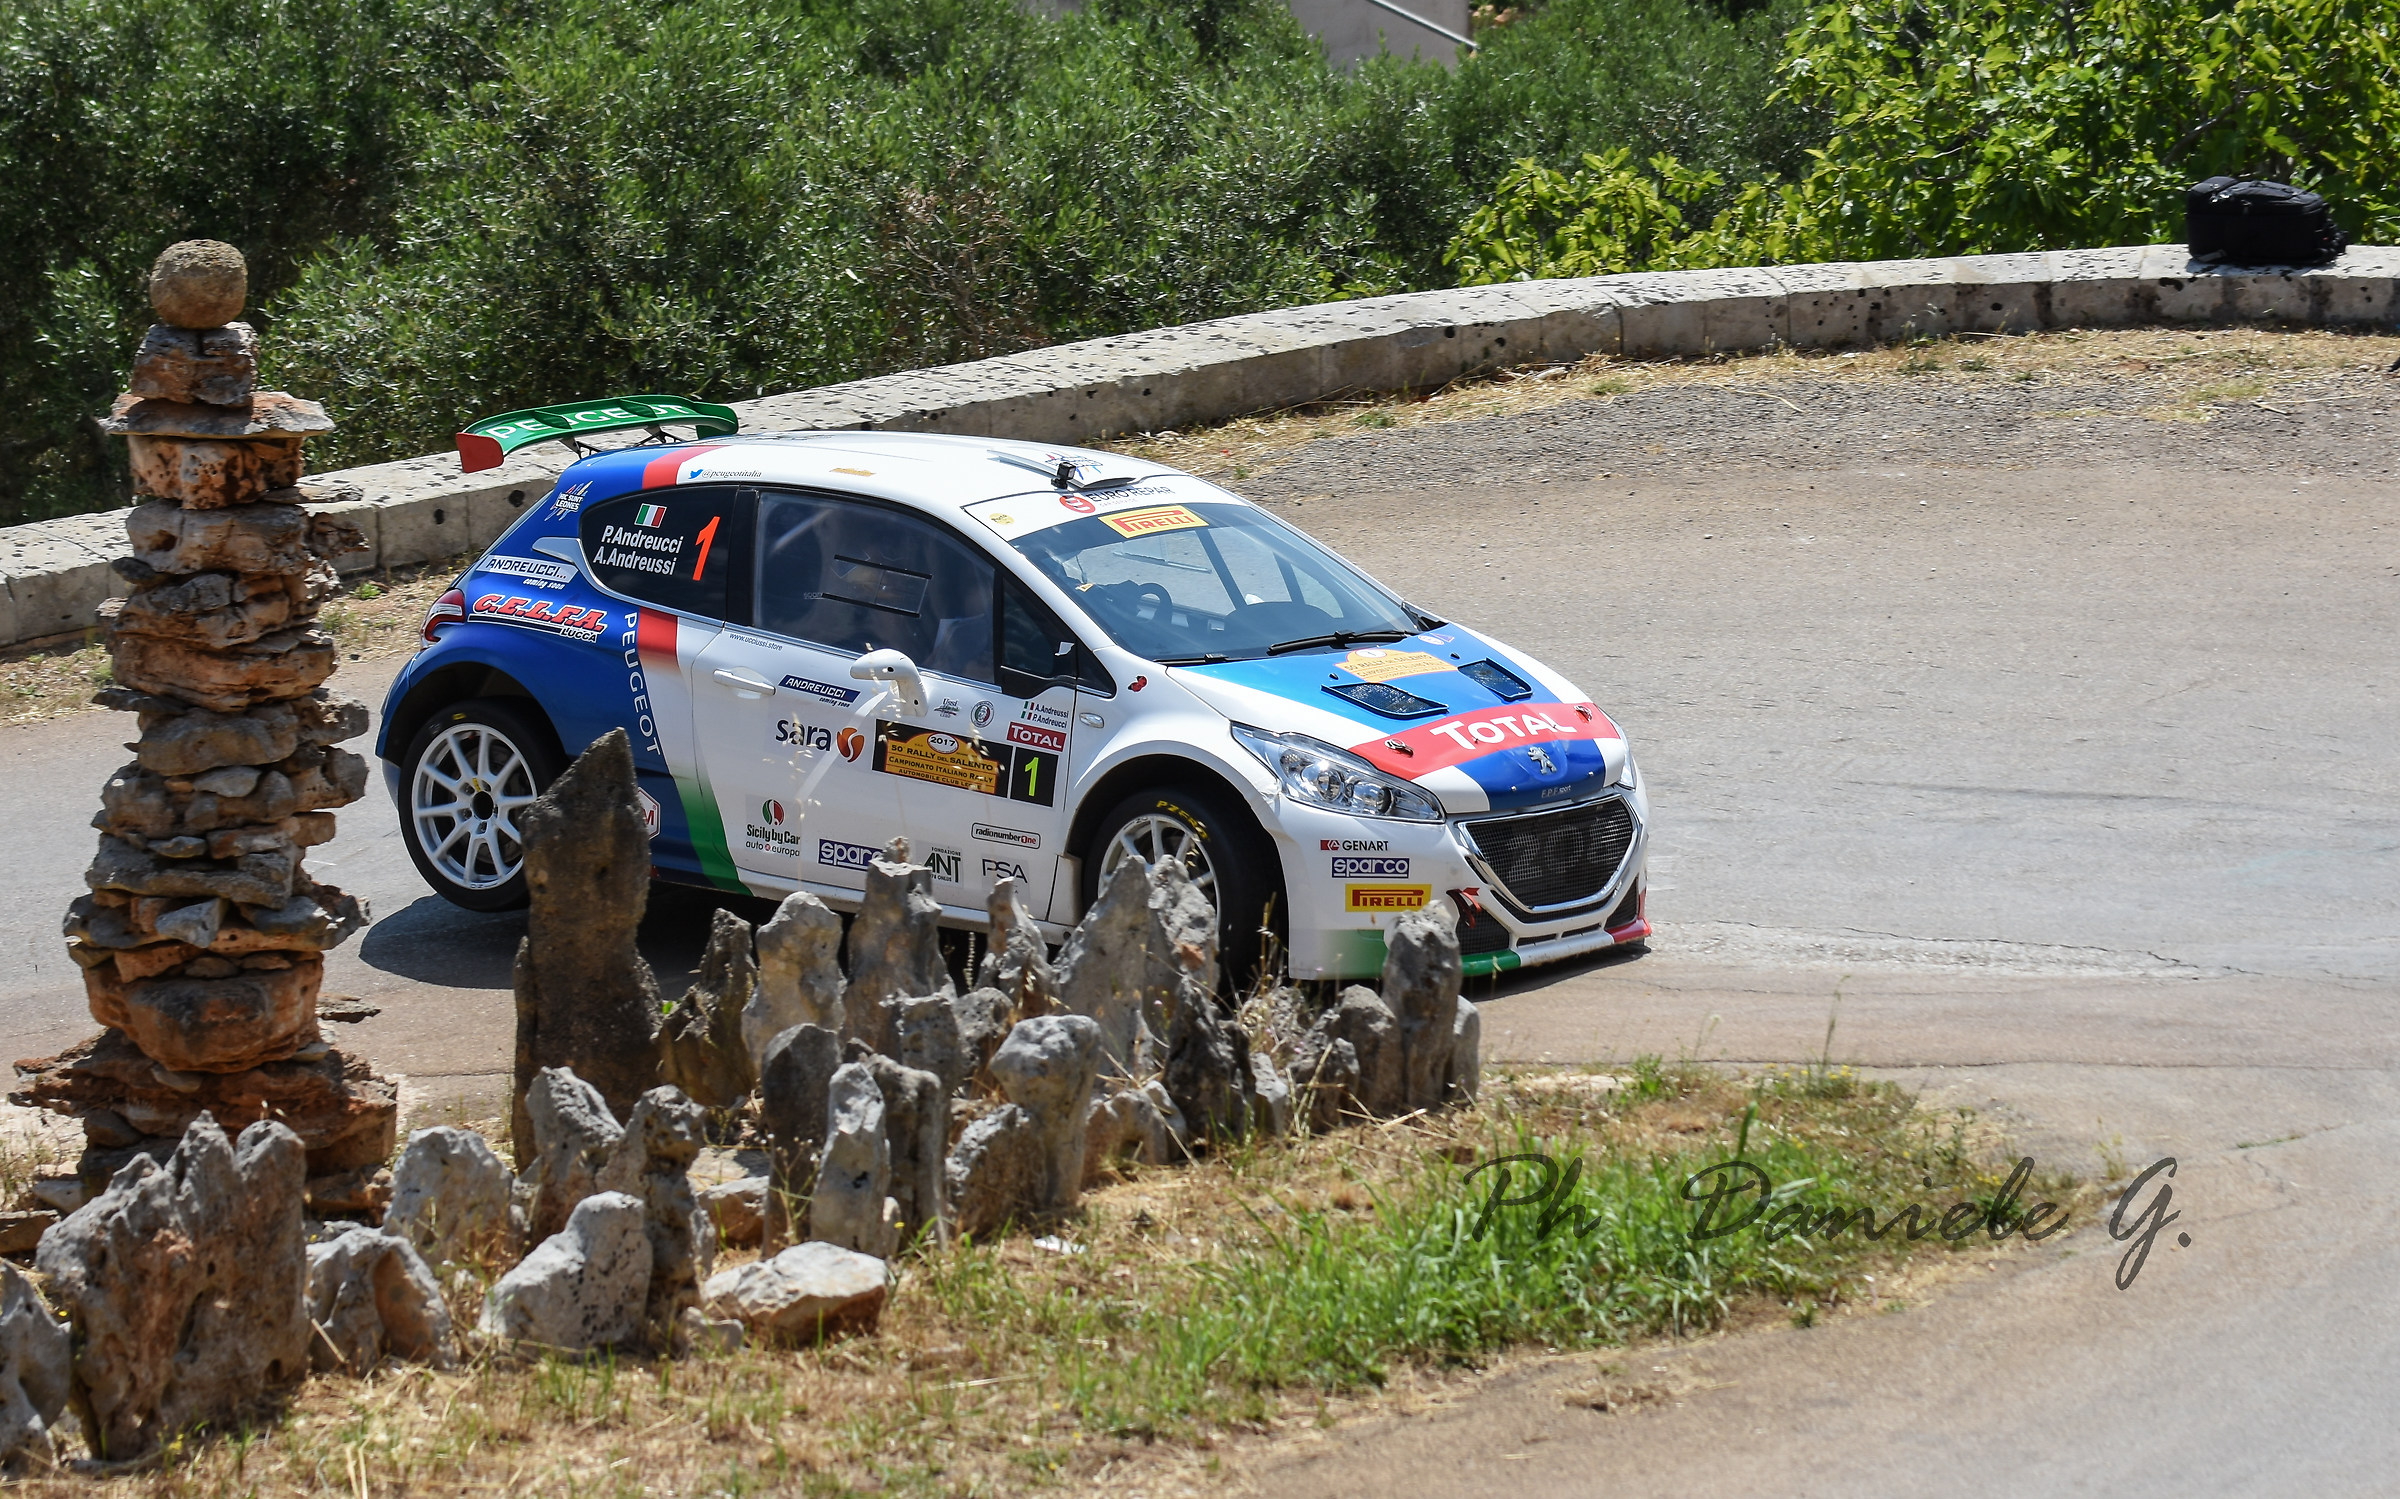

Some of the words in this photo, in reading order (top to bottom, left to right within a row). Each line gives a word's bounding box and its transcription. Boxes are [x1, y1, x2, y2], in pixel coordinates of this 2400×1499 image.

[1112, 510, 1195, 533] PIRELLI
[602, 525, 684, 554] P.Andreucci
[692, 516, 721, 581] 1
[593, 546, 677, 575] A.Andreussi
[523, 578, 545, 590] coming
[547, 582, 566, 590] soon
[473, 593, 608, 634] C.E.L.F.A.
[561, 626, 598, 643] LUCCA
[622, 611, 661, 757] PEUGEOT
[786, 678, 846, 698] ANDREUCCI
[819, 697, 838, 707] coming
[1035, 703, 1070, 719] A.Andreussi
[1032, 713, 1068, 729] P.Andreucci
[1429, 712, 1577, 750] TOTAL
[775, 719, 832, 751] sara
[930, 736, 956, 747] 2017
[1011, 724, 1063, 749] TOTAL
[889, 756, 934, 771] CAMPIONATO
[936, 765, 968, 778] ITALIANO
[907, 748, 936, 759] RALLY
[949, 757, 994, 771] SALENTO
[899, 768, 940, 781] AUTOMOBILE
[941, 777, 960, 786] CLUB
[1025, 756, 1039, 797] 1
[745, 841, 764, 851] auto
[771, 845, 800, 858] europa
[1342, 840, 1389, 851] GENART
[924, 852, 962, 883] ANT
[981, 858, 1028, 884] PSA
[1333, 858, 1409, 877] sparco
[1352, 889, 1424, 907] PIRELLI
